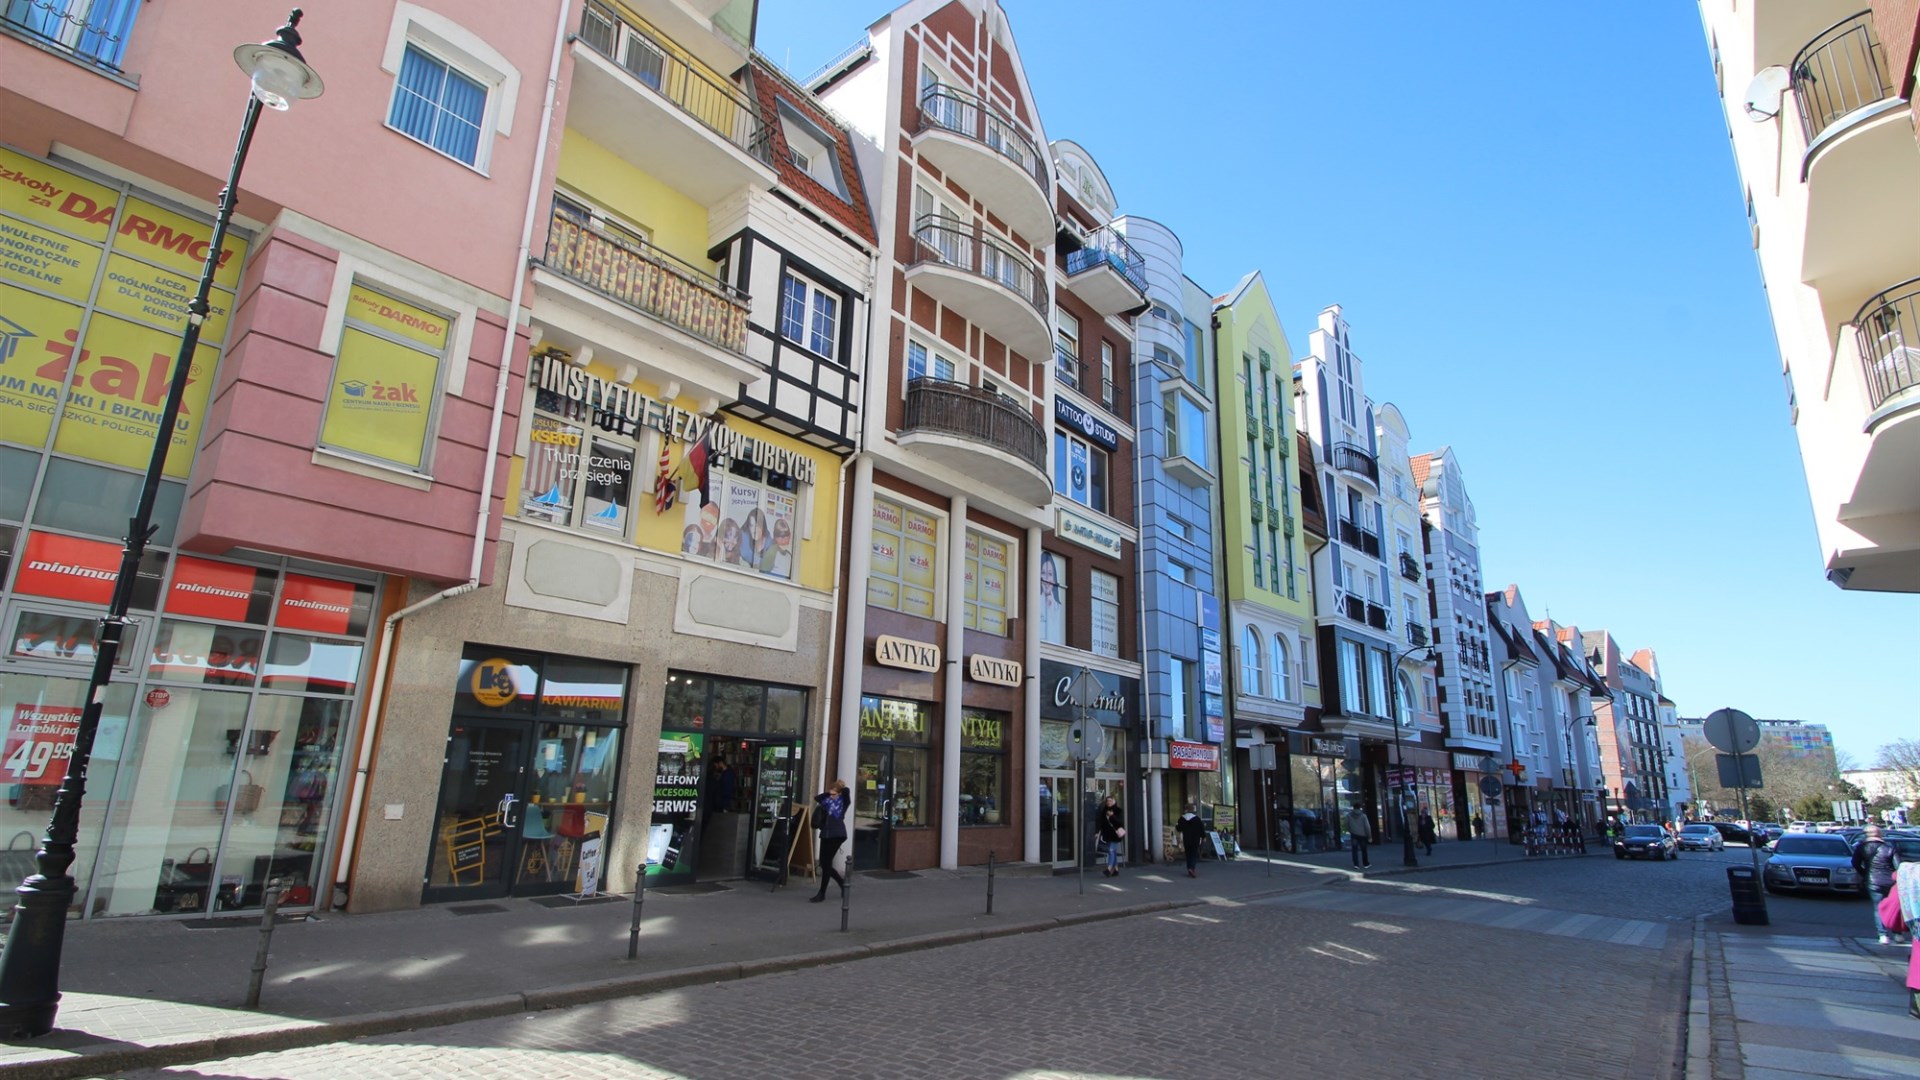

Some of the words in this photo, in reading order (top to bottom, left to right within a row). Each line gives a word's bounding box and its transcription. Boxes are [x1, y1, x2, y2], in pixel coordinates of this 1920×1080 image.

[28, 195, 52, 208] za
[118, 286, 141, 299] DLA
[155, 276, 187, 292] LICEA
[143, 305, 182, 322] KURSY
[378, 305, 443, 336] DARMO!
[36, 328, 196, 415] żak
[371, 380, 418, 403] żak
[111, 403, 189, 431] BIZNEU
[540, 355, 661, 426] INSTYTUT
[751, 438, 816, 486] OBCYCH
[1056, 399, 1083, 425] TATTOO
[1094, 423, 1116, 445] STUDIO
[531, 429, 580, 447] KSERO
[543, 447, 631, 471] Tłumaczenia
[730, 486, 757, 497] Kursy
[175, 583, 249, 599] minimum
[284, 598, 349, 613] minimum
[879, 640, 936, 668] ANTYKI
[972, 660, 1018, 682] ANTYKI
[541, 696, 622, 711] KAWIARNIA
[19, 710, 81, 724] Wszystkie
[16, 723, 61, 735] torebki
[4, 740, 54, 779] 49
